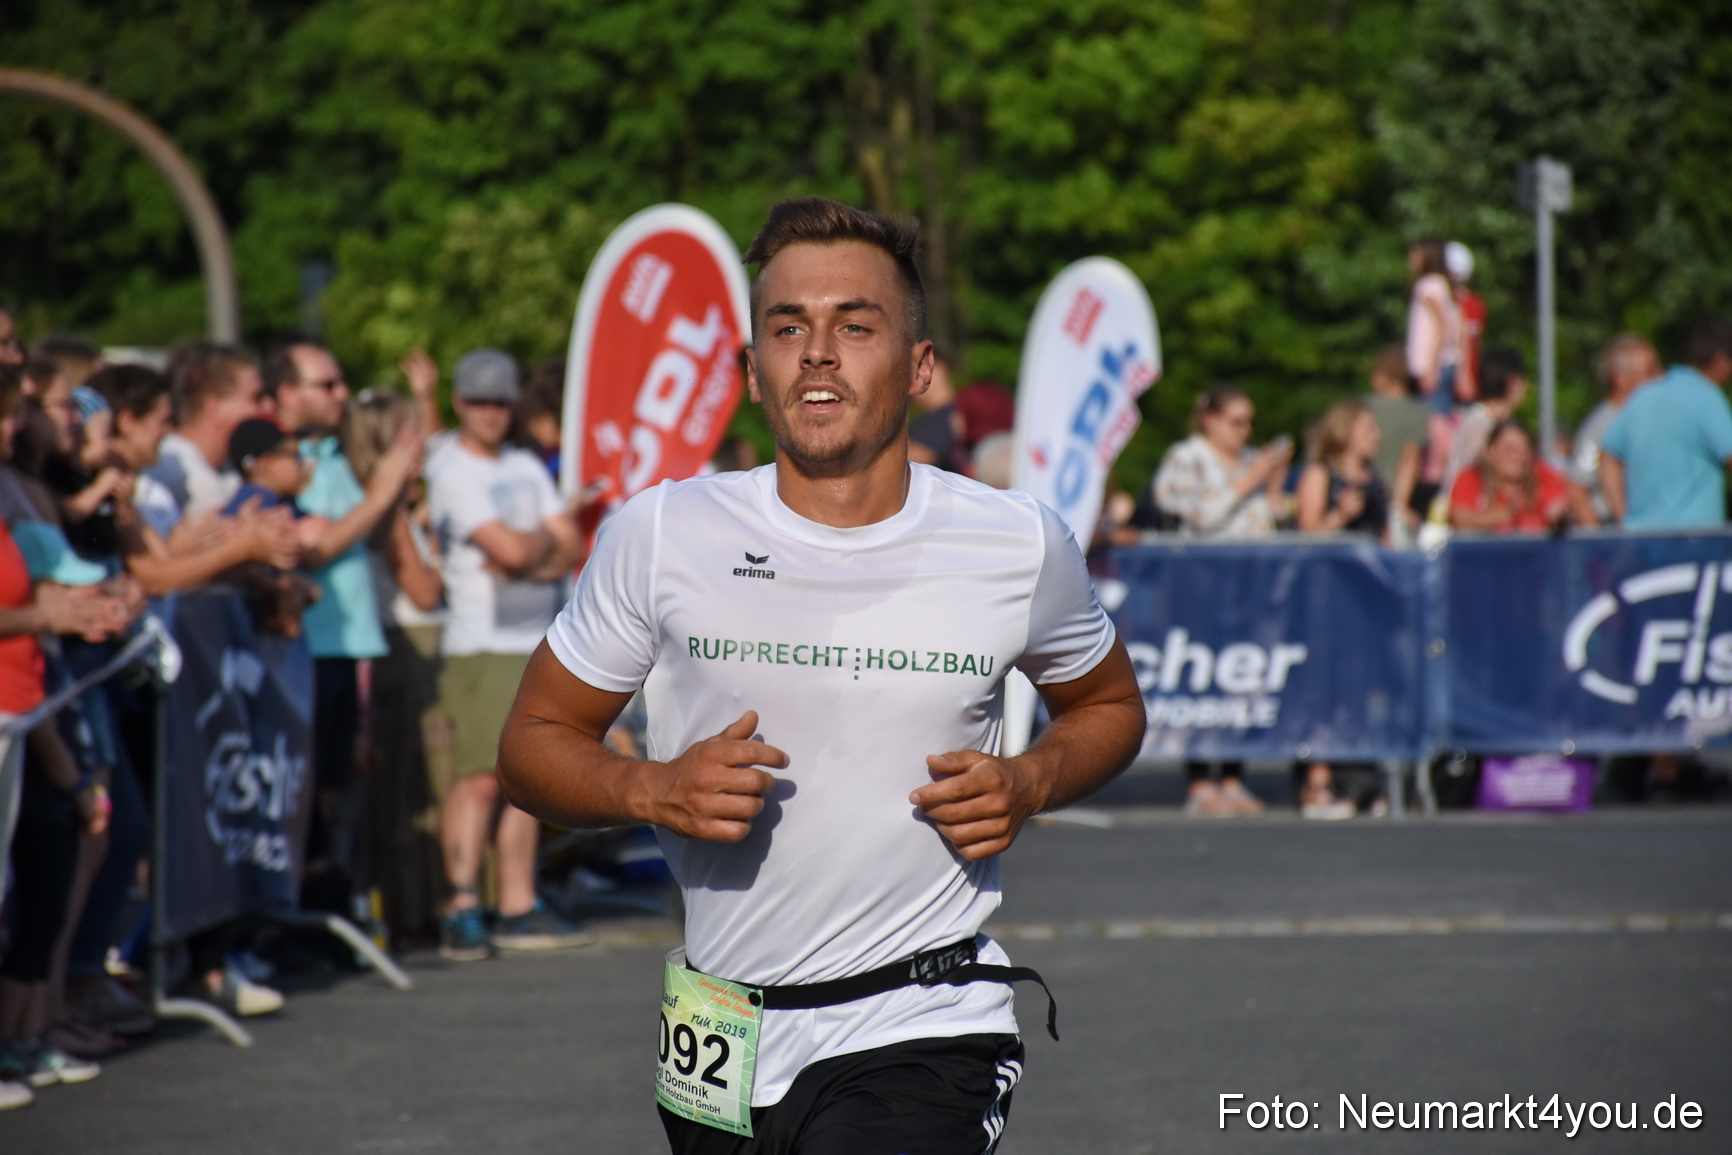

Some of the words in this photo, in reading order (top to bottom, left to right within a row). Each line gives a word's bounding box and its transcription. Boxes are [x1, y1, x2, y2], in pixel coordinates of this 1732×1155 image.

[733, 566, 775, 580] erima
[688, 636, 848, 667] RUPPRECHT
[866, 648, 994, 677] HOLZBAU
[1665, 686, 1732, 720] AU
[662, 994, 679, 1008] auf
[715, 1021, 747, 1038] 2019
[665, 1070, 709, 1099] Dominik
[665, 1086, 694, 1106] Holzbau
[695, 1099, 721, 1115] GmbH
